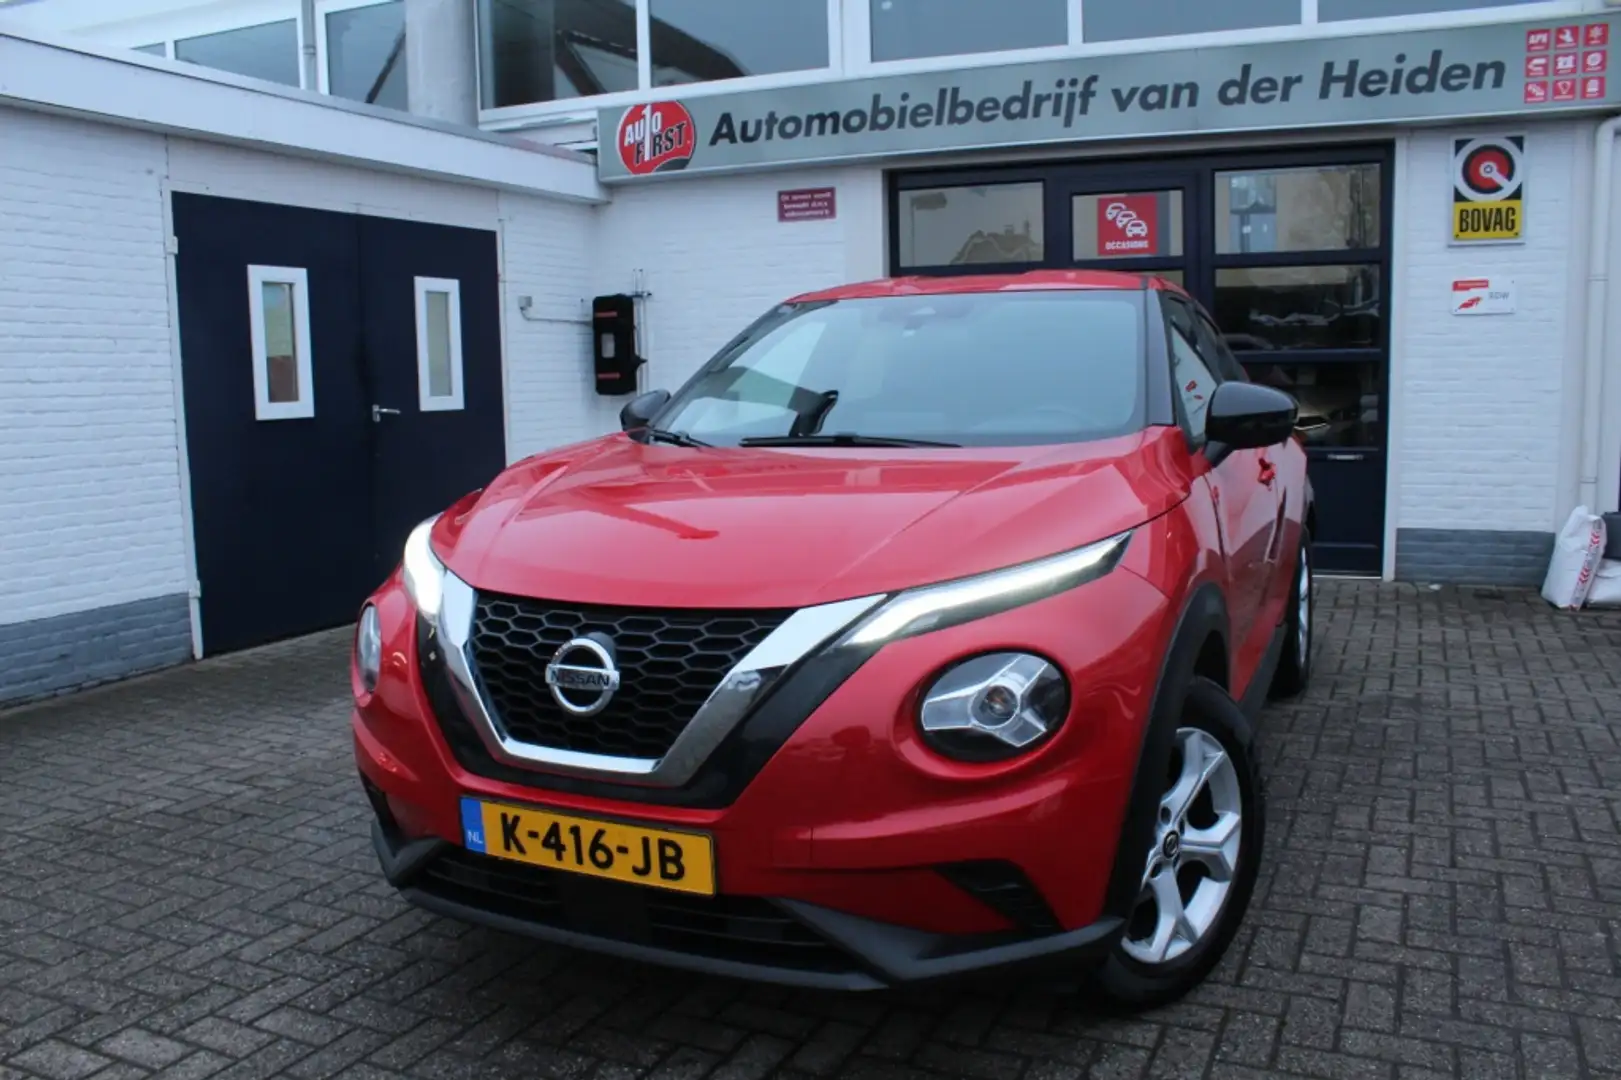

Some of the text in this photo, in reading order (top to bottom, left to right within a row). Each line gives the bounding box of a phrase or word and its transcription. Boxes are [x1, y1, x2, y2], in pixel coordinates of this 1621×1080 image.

[709, 50, 1506, 146] Automobielbedrijf van der Heiden
[1459, 206, 1516, 233] BOVAG
[550, 669, 610, 687] NISSAN
[468, 829, 483, 844] NL
[501, 812, 685, 881] K-416-JB
